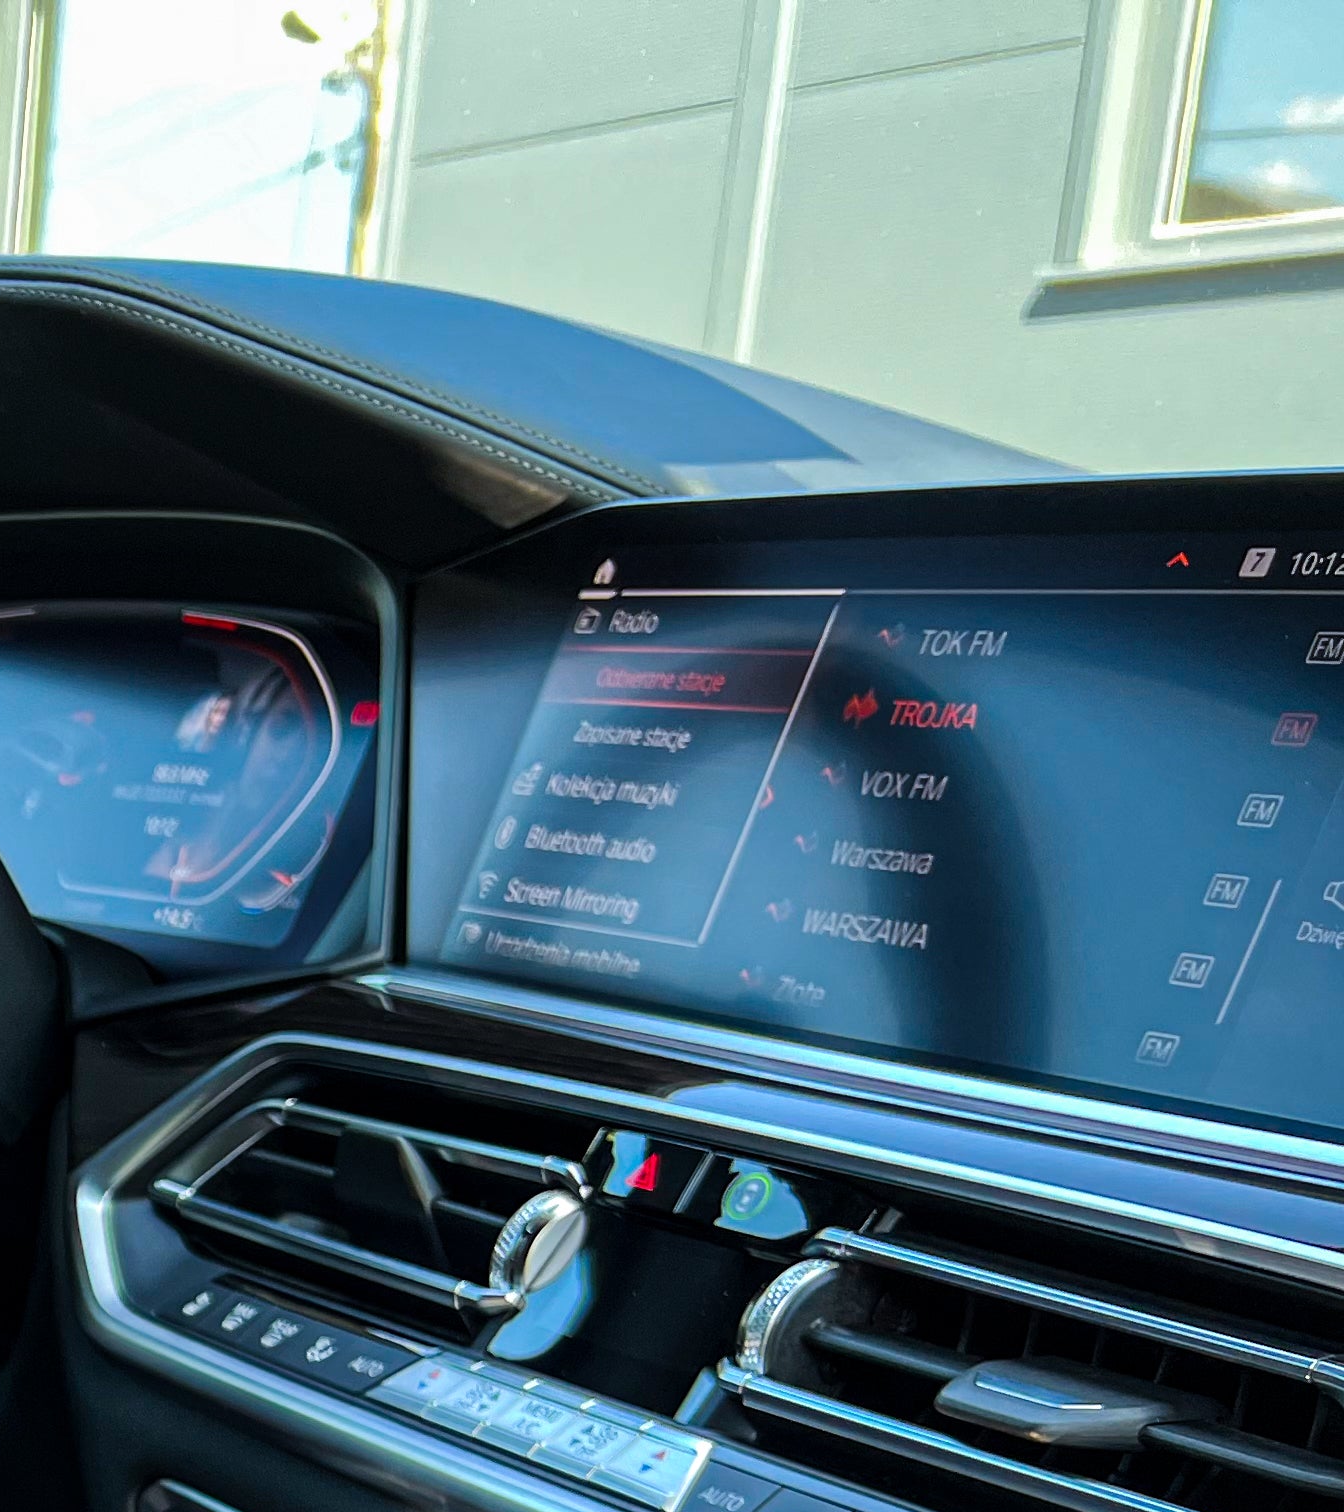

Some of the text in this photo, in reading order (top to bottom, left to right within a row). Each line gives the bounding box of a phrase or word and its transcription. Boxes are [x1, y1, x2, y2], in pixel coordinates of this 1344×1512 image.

[1291, 552, 1344, 575] 10:12
[608, 608, 660, 634] Radio
[919, 629, 1008, 657] TOK FM
[1313, 637, 1344, 659] FM
[890, 699, 978, 730] TROJKA
[1279, 718, 1310, 741] FM
[861, 771, 949, 801] VOX FM
[1244, 802, 1275, 822] FM
[524, 824, 657, 863] Bluetooth audio
[831, 839, 934, 875] Warszawa
[504, 877, 640, 925] Screen Mirroring
[1210, 880, 1241, 901] FM
[802, 908, 929, 950] WARSZAWA
[1176, 959, 1205, 981] FM
[1142, 1038, 1172, 1060] FM
[697, 1486, 746, 1512] AUTO
